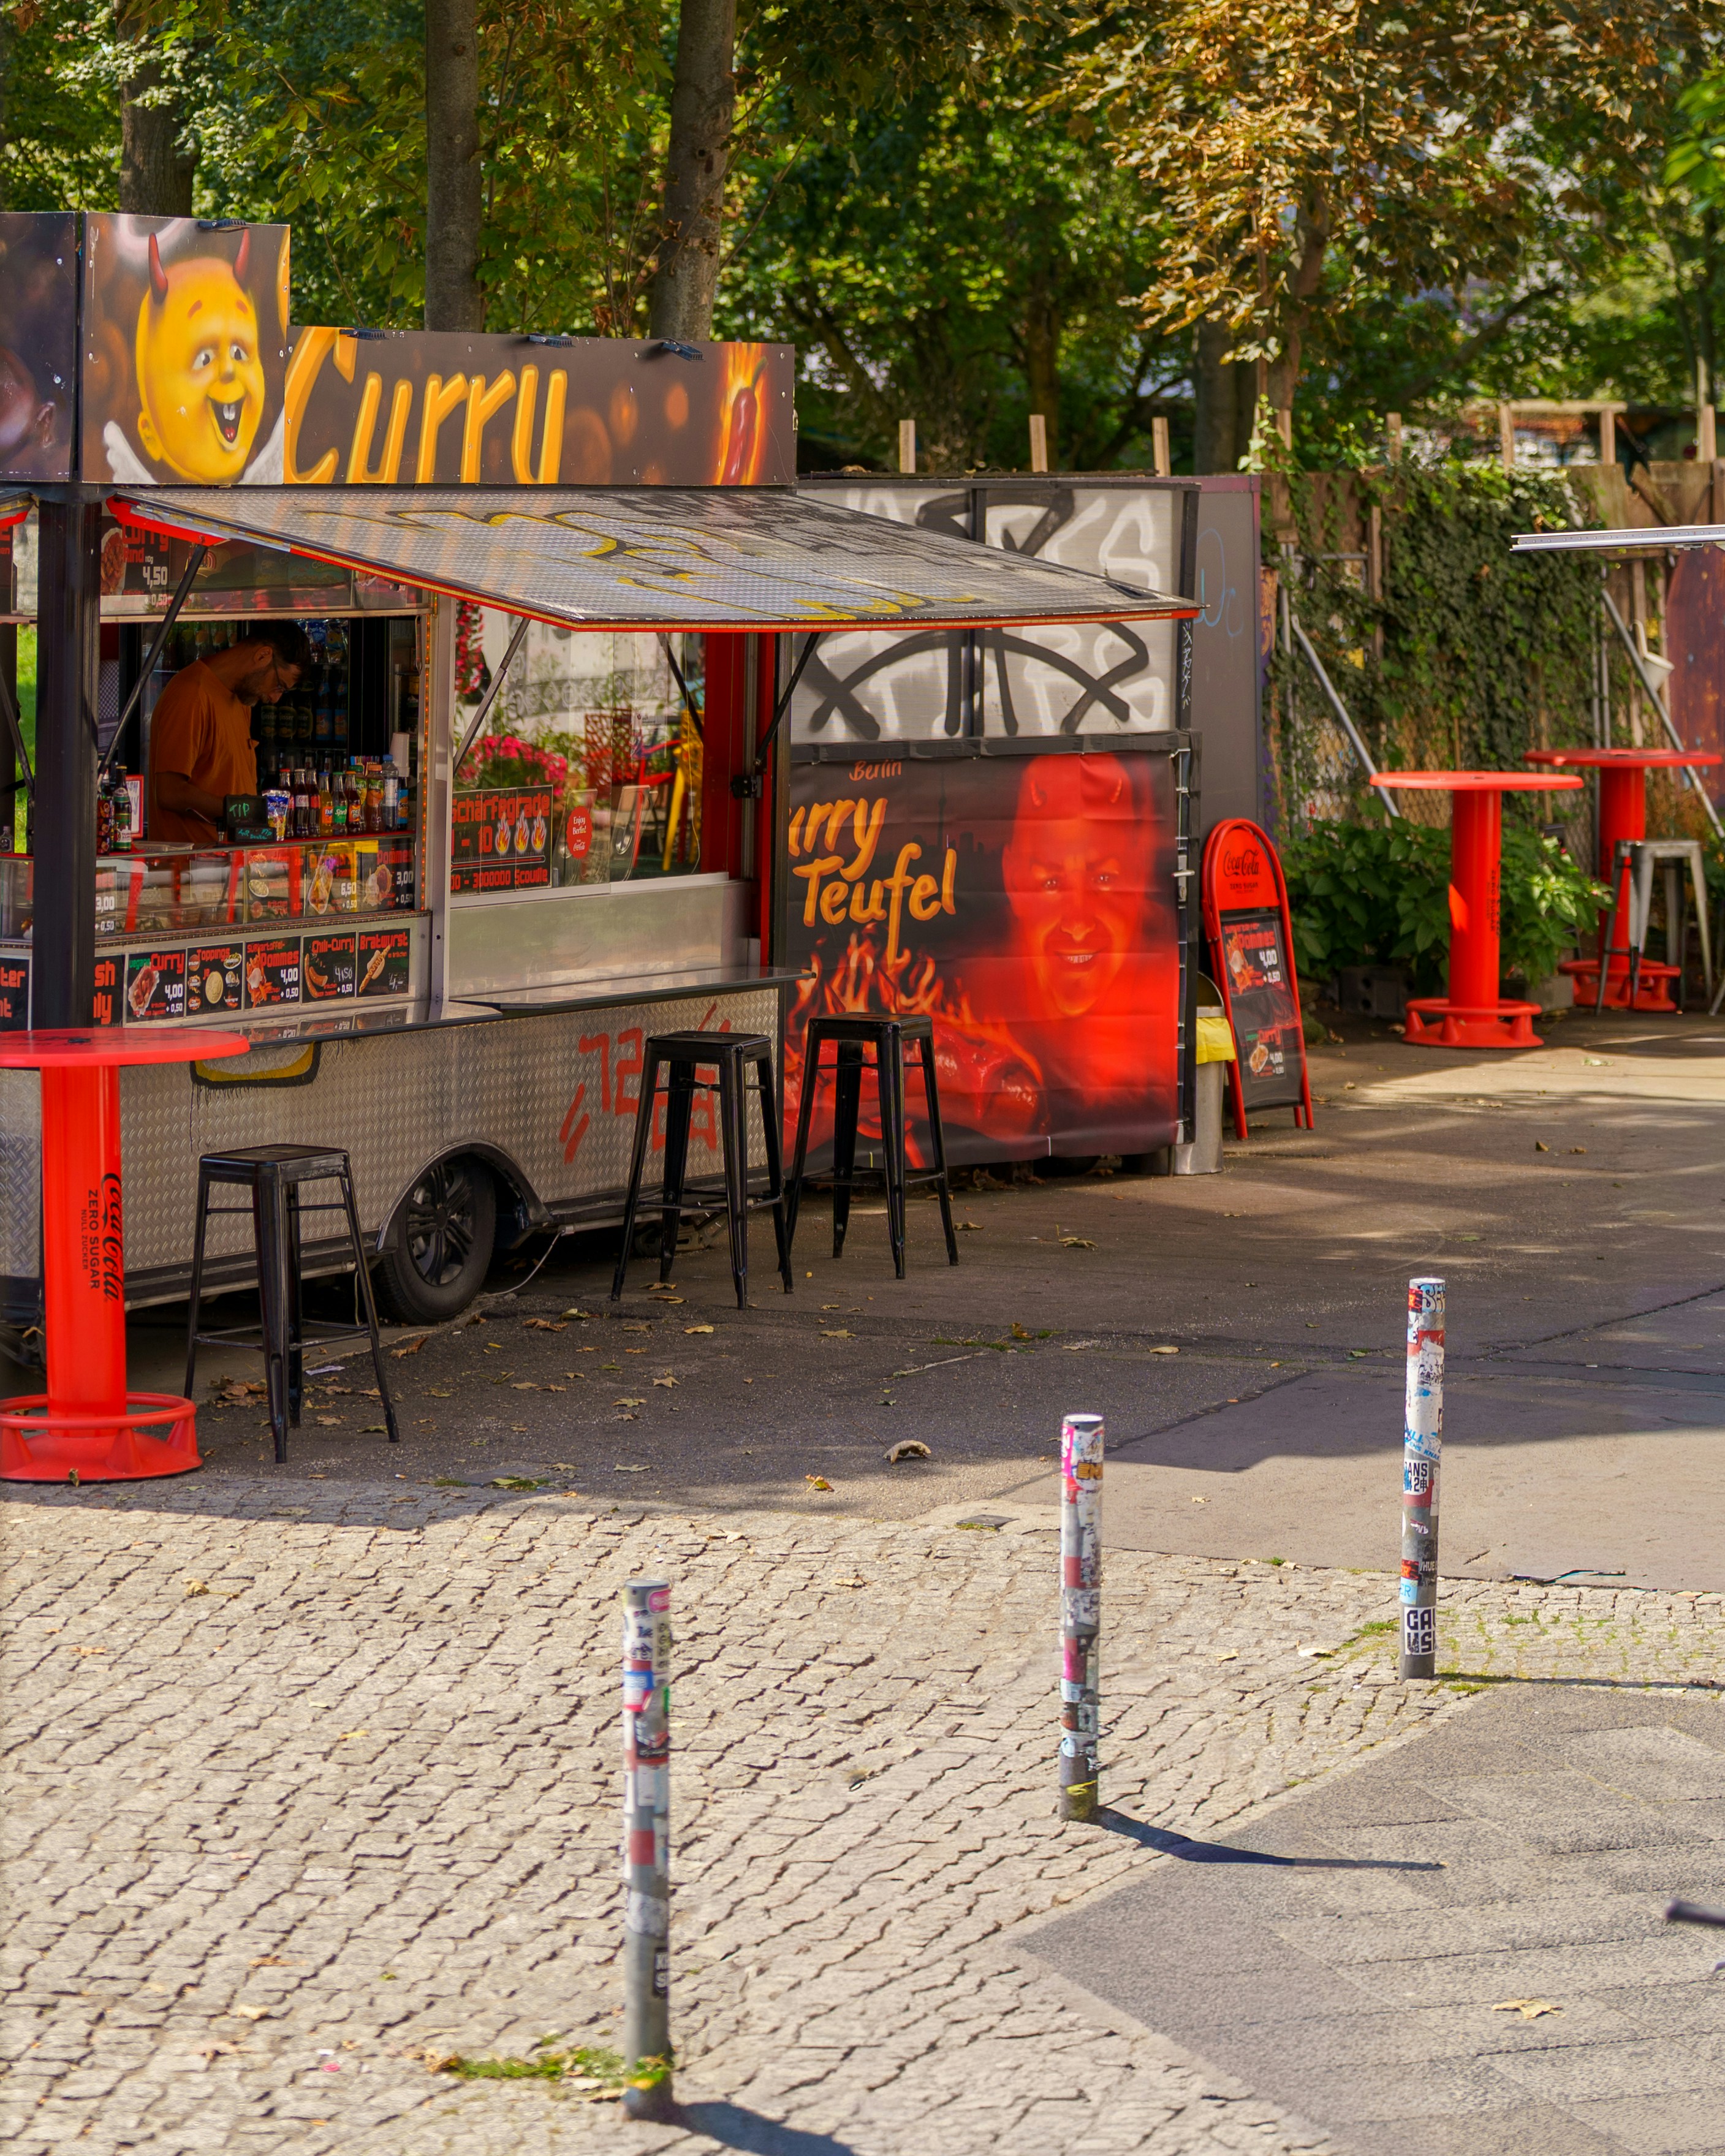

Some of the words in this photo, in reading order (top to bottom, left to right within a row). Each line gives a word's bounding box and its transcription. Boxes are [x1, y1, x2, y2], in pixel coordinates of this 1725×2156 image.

[284, 327, 567, 485] Curry
[143, 566, 167, 589] 4,50
[849, 760, 902, 782] Berlin
[229, 803, 249, 817] TIP
[452, 793, 550, 825] Schärfegrade
[573, 815, 586, 826] Enjoy
[478, 826, 493, 853] 10
[1223, 849, 1260, 877] Coca-Cola
[396, 871, 413, 886] 3,00
[341, 882, 357, 896] 6,50
[96, 896, 115, 913] 3,00
[346, 900, 357, 909] 0,50
[400, 894, 413, 904] 0,50
[792, 842, 957, 970] Teufel
[100, 920, 115, 932] 0,50
[360, 931, 409, 951] Bratwurst
[150, 953, 184, 974] Curry
[260, 950, 299, 967] Pommes
[1259, 948, 1278, 969] 4,00
[281, 967, 298, 985] 4,00
[165, 983, 183, 1001] 4,00
[286, 987, 298, 999] 0,50
[342, 983, 353, 994] 0,50
[170, 1002, 183, 1013] 0,50
[1269, 1051, 1283, 1065] 4,00
[88, 1189, 99, 1231] ZERO
[100, 1173, 123, 1302] Coca-Cola
[89, 1236, 100, 1290] SUGAR
